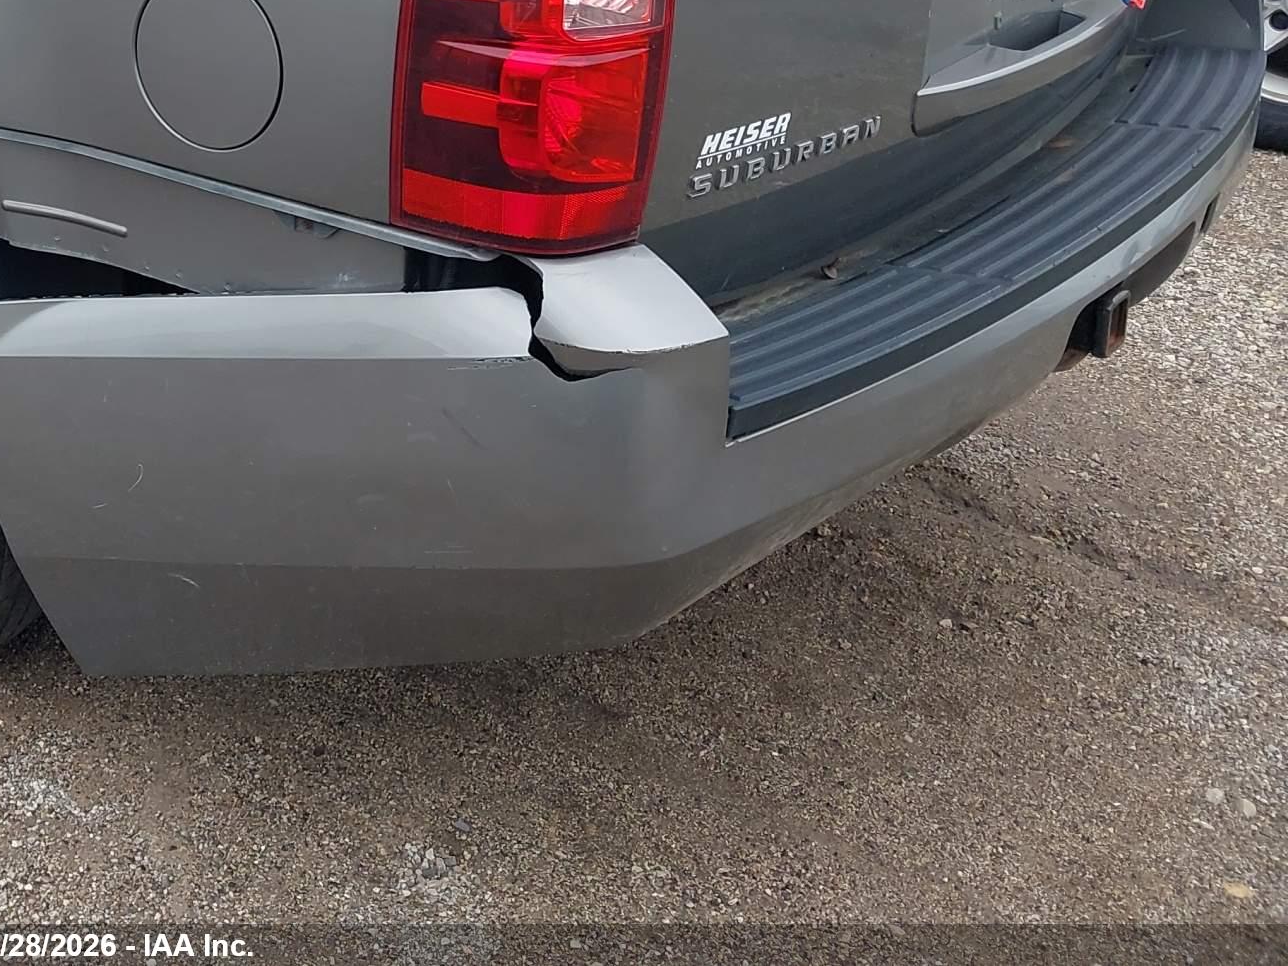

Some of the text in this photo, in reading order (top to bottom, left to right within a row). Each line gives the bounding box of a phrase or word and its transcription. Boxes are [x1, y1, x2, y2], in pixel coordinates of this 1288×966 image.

[695, 137, 787, 170] AUTOMOTIVE
[700, 112, 792, 156] HEISER
[687, 115, 882, 199] SUBURBAN
